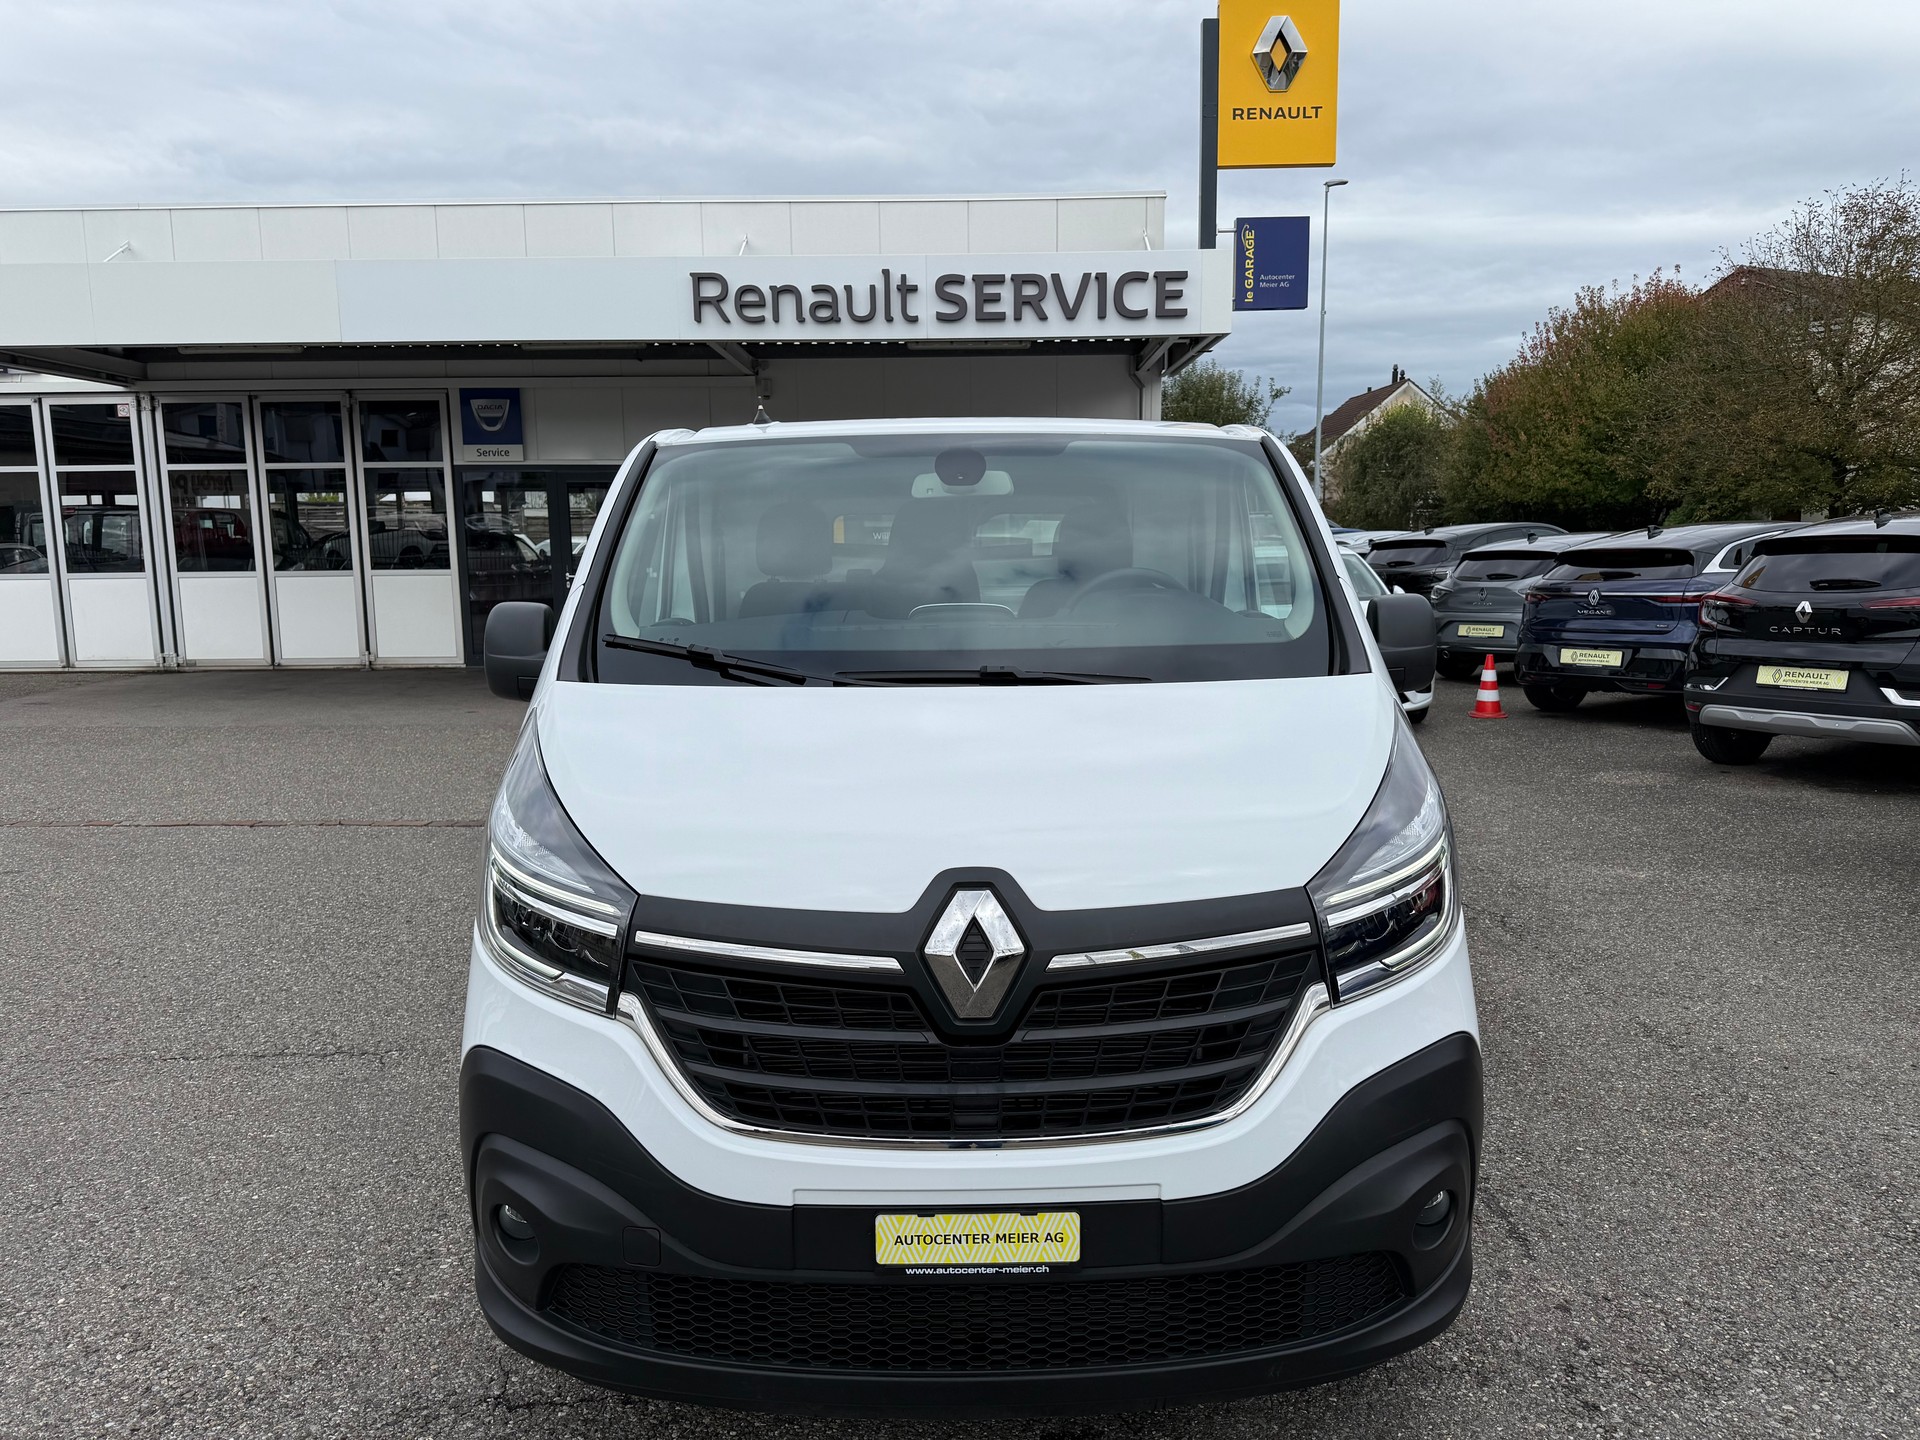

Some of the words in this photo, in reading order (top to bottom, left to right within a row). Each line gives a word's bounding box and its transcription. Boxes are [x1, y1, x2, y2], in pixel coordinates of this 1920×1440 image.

[1232, 105, 1323, 121] RENAULT
[1244, 229, 1255, 289] GARAGE
[689, 268, 919, 324] Renault
[934, 270, 1189, 322] SERVICE
[1244, 291, 1254, 302] le
[476, 448, 510, 457] Service
[1769, 625, 1842, 635] CAPTUR
[1784, 670, 1831, 680] RENAULT
[894, 1233, 991, 1246] AUTOCENTER
[995, 1232, 1040, 1244] MEIER
[1043, 1231, 1065, 1243] AG
[905, 1264, 1050, 1275] www.autocenter-meier.ch
